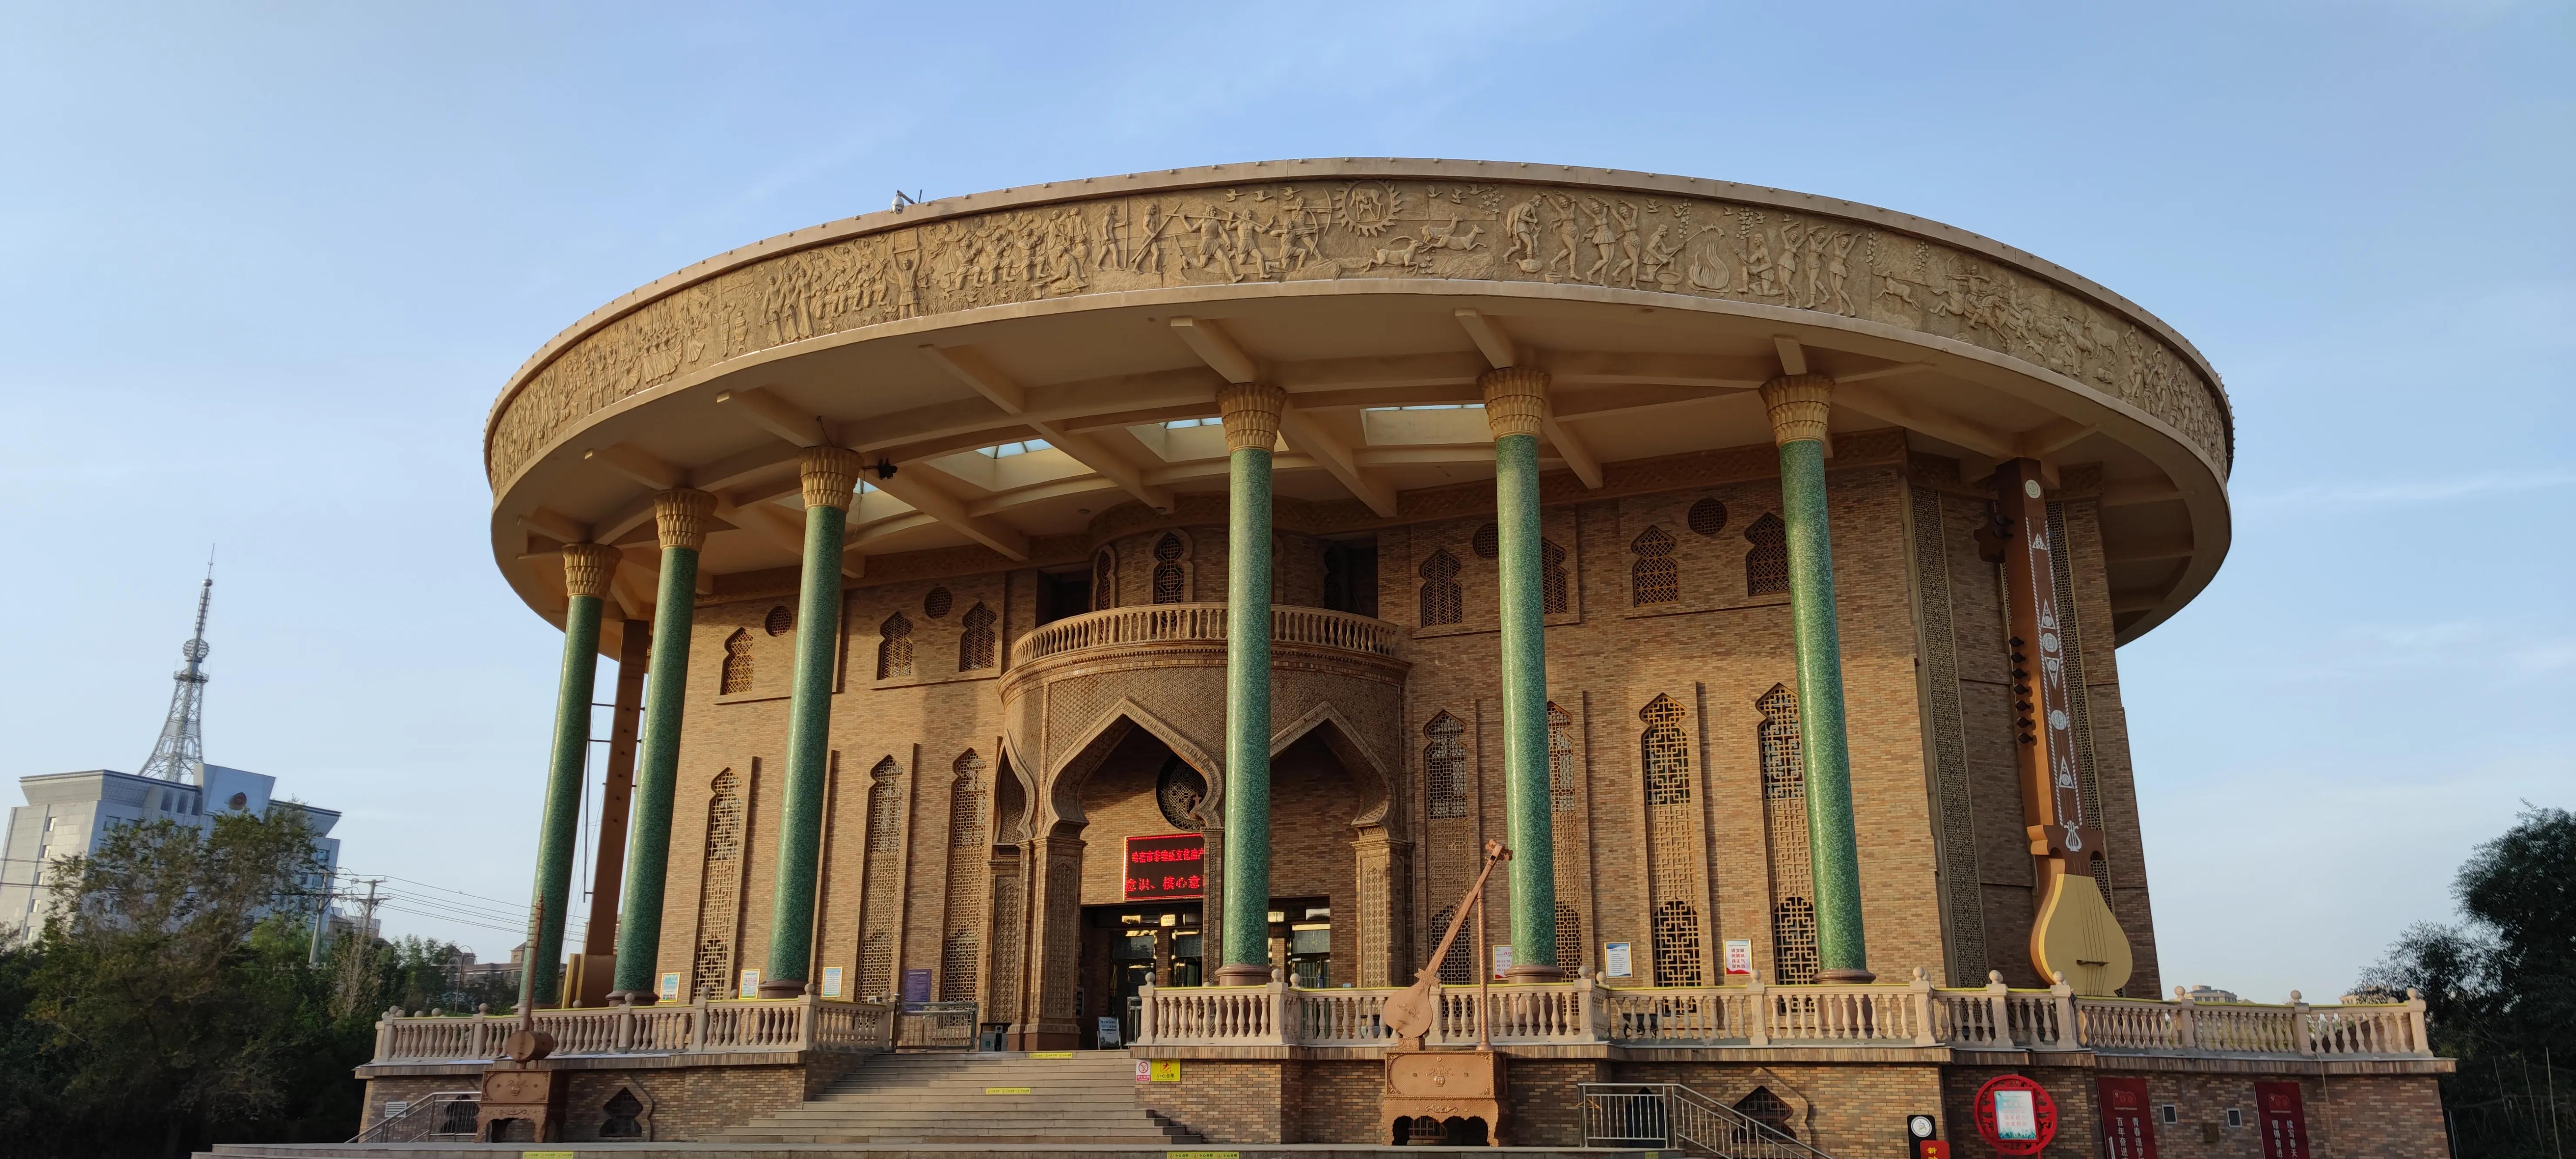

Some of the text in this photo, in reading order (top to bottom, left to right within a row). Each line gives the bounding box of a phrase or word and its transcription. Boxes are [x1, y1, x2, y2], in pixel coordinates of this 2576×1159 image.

[1126, 875, 1204, 891] 意识、核心意
[2116, 1117, 2129, 1159] 百年奋进
[2132, 1117, 2144, 1159] 青春逐梦
[2272, 1120, 2283, 1159] 铿锵奋进
[2287, 1120, 2298, 1159] 续写春天
